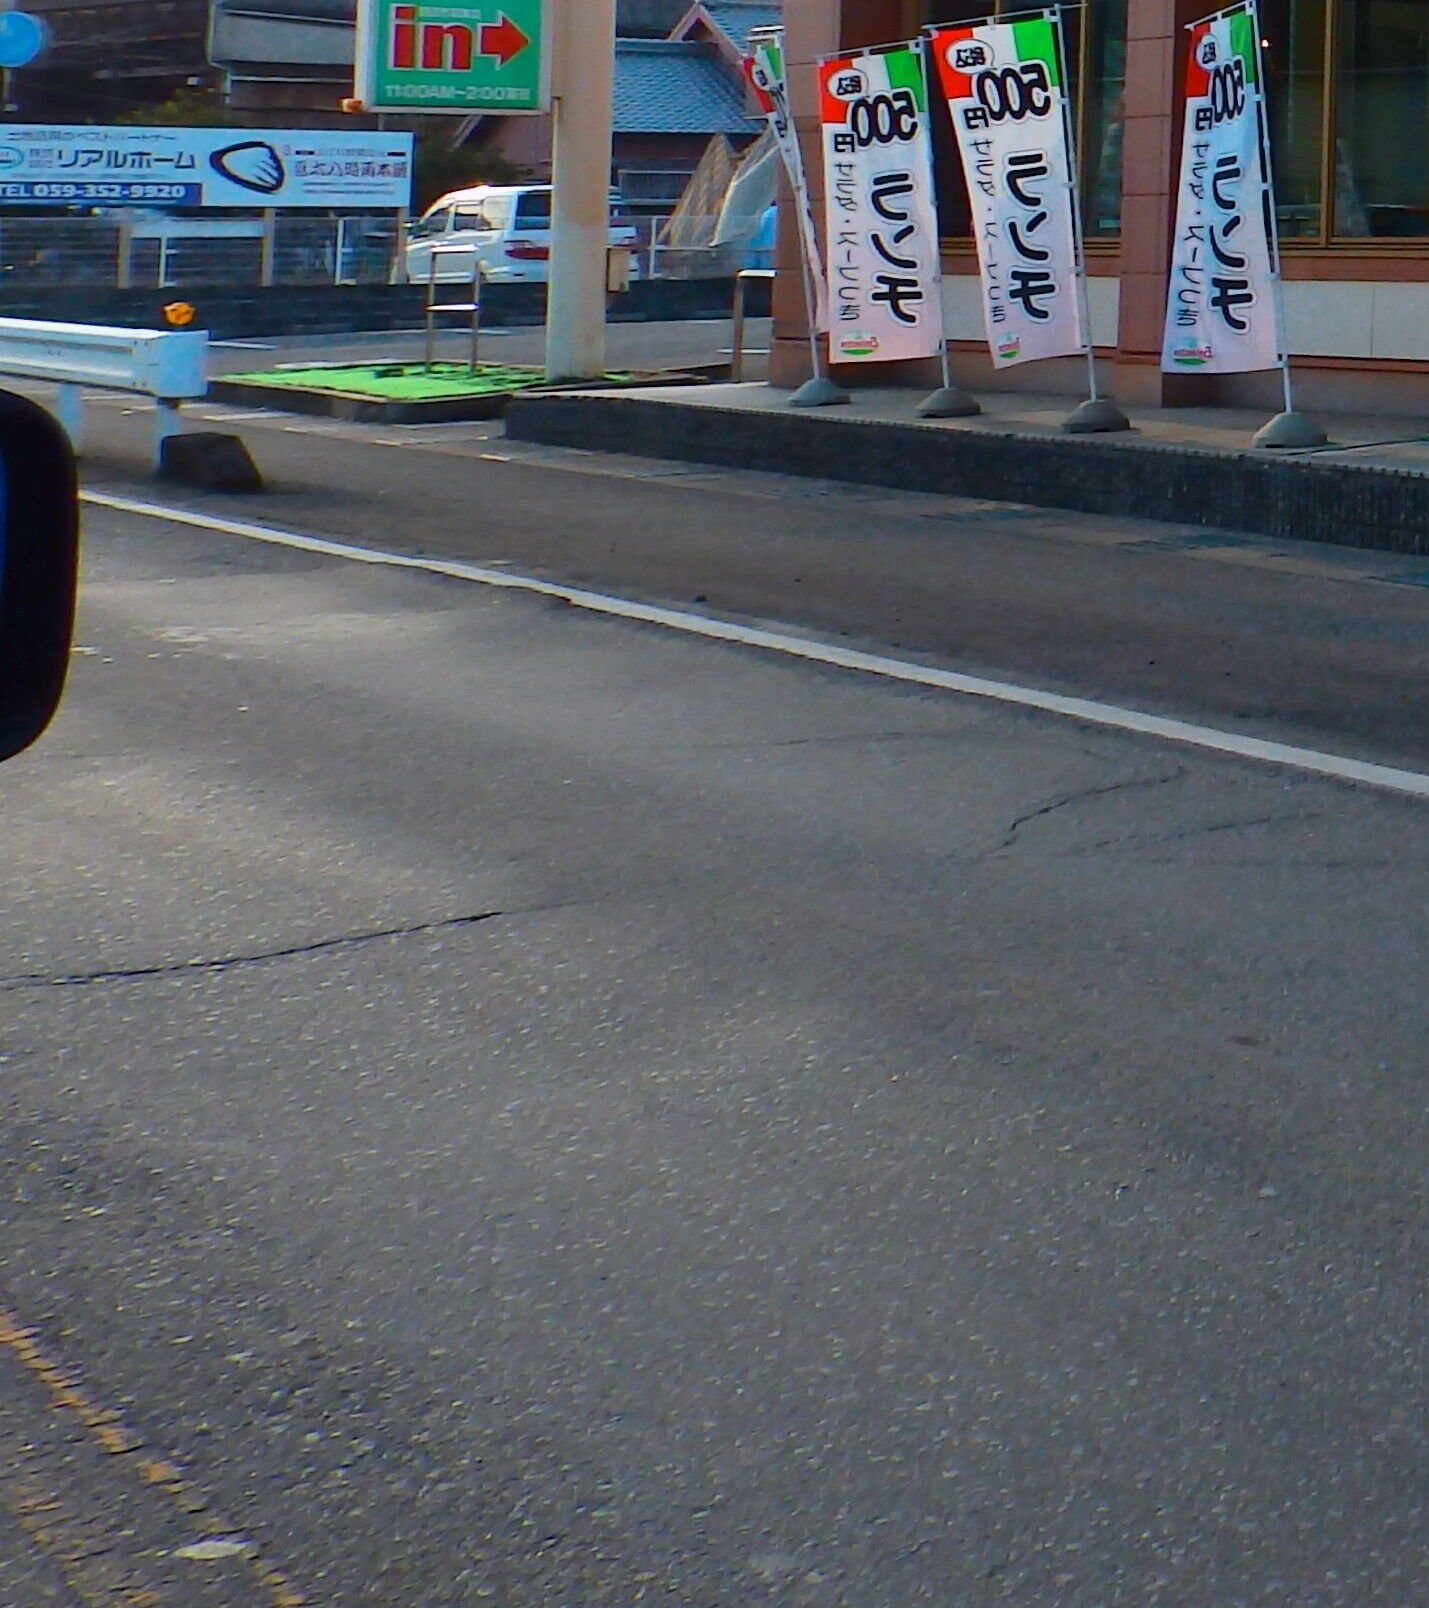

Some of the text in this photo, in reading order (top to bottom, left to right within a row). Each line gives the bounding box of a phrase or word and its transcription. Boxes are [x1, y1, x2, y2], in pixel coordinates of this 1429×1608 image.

[388, 4, 473, 71] in
[58, 148, 197, 170] リアルホーム
[0, 183, 31, 198] TEL
